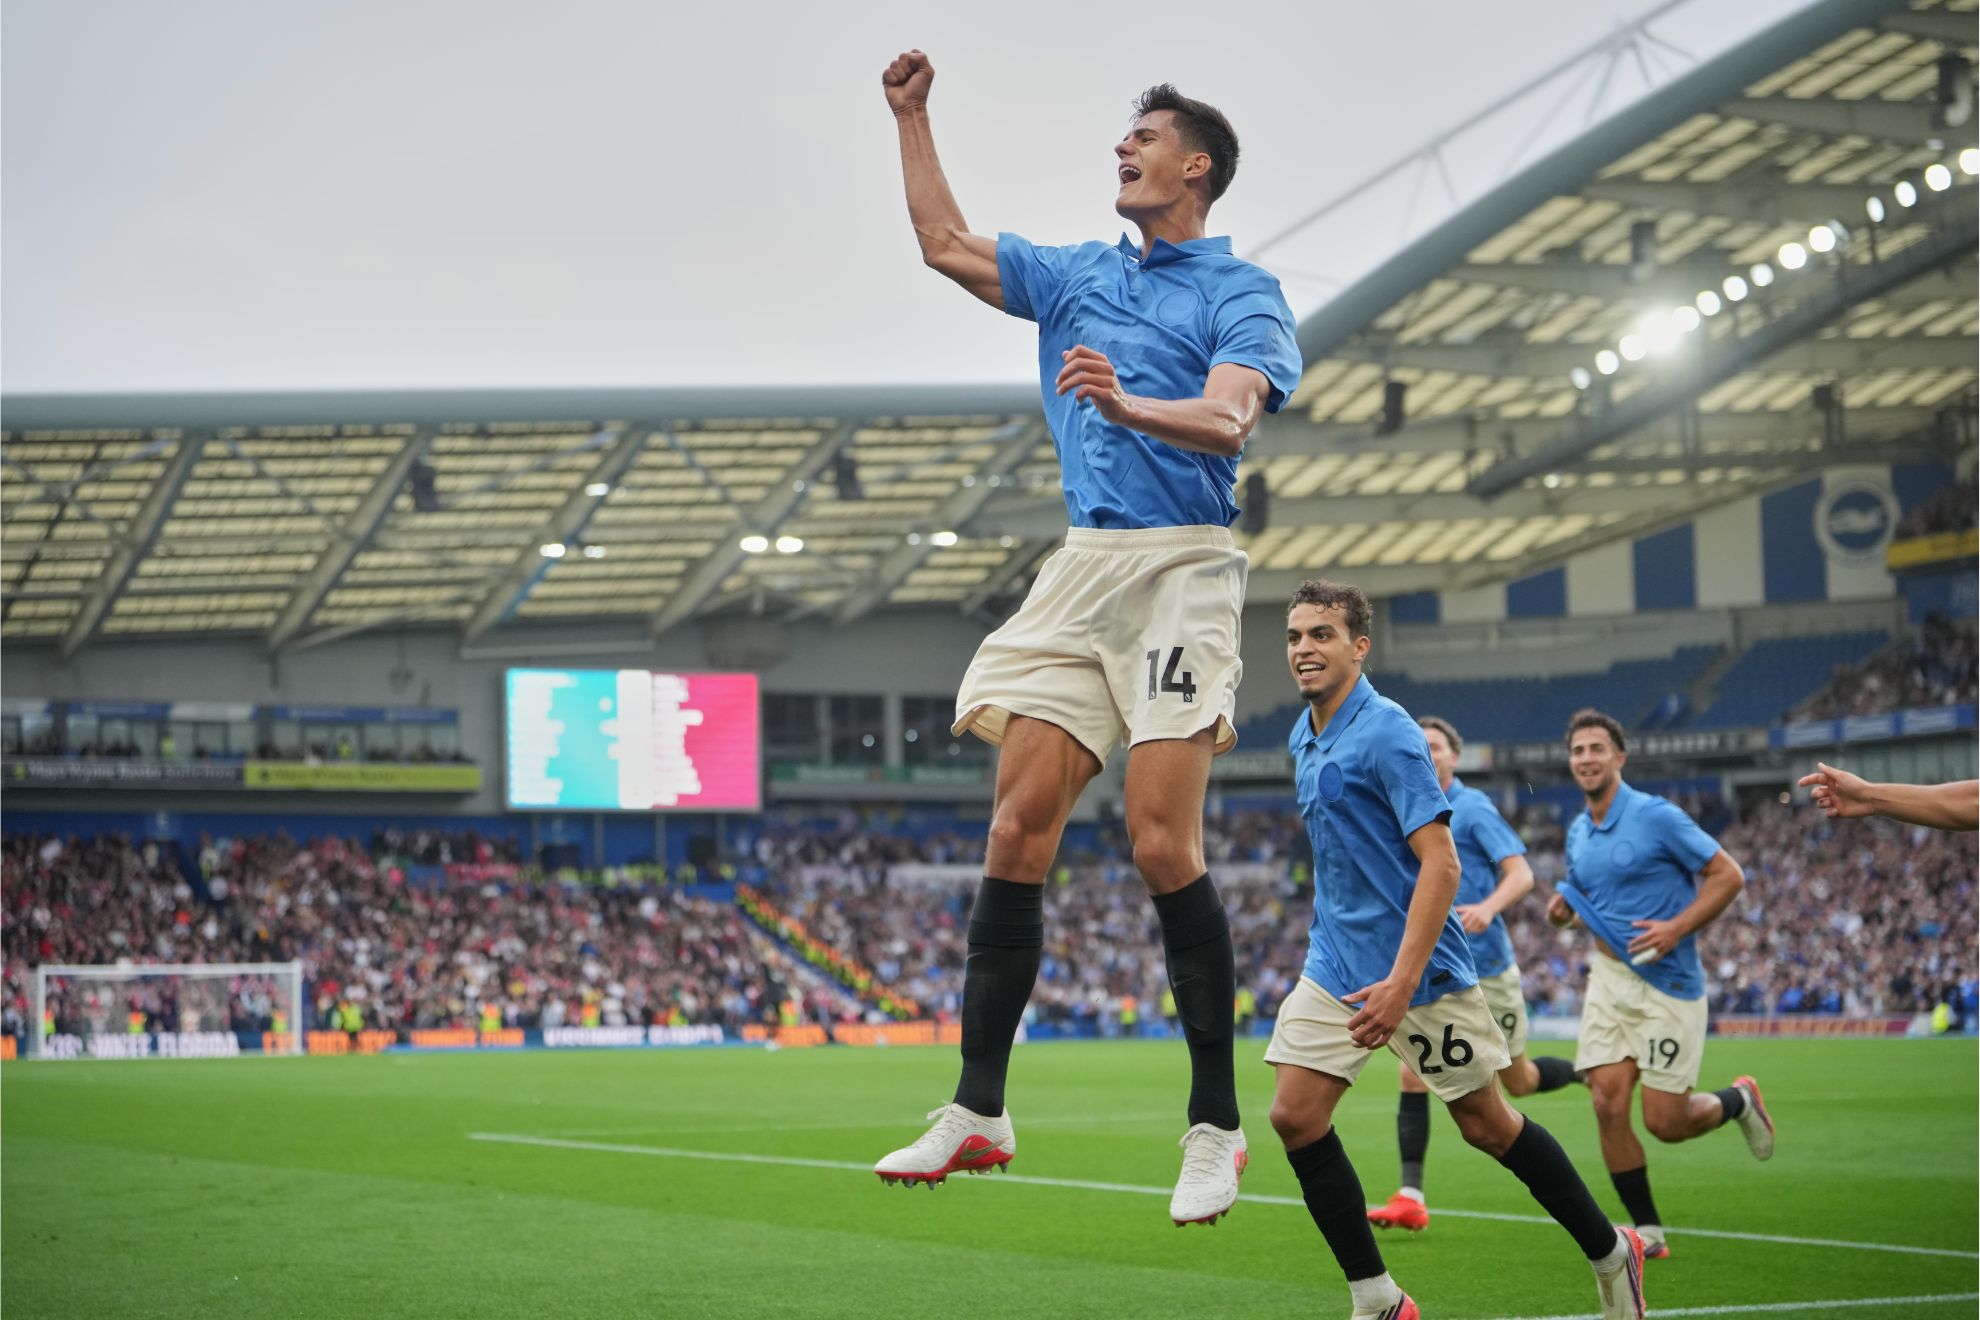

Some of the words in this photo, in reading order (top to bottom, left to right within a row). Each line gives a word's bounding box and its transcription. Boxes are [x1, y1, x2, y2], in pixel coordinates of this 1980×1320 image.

[1146, 646, 1197, 703] 14
[1408, 1023, 1474, 1074] 26
[1648, 1038, 1680, 1069] 19
